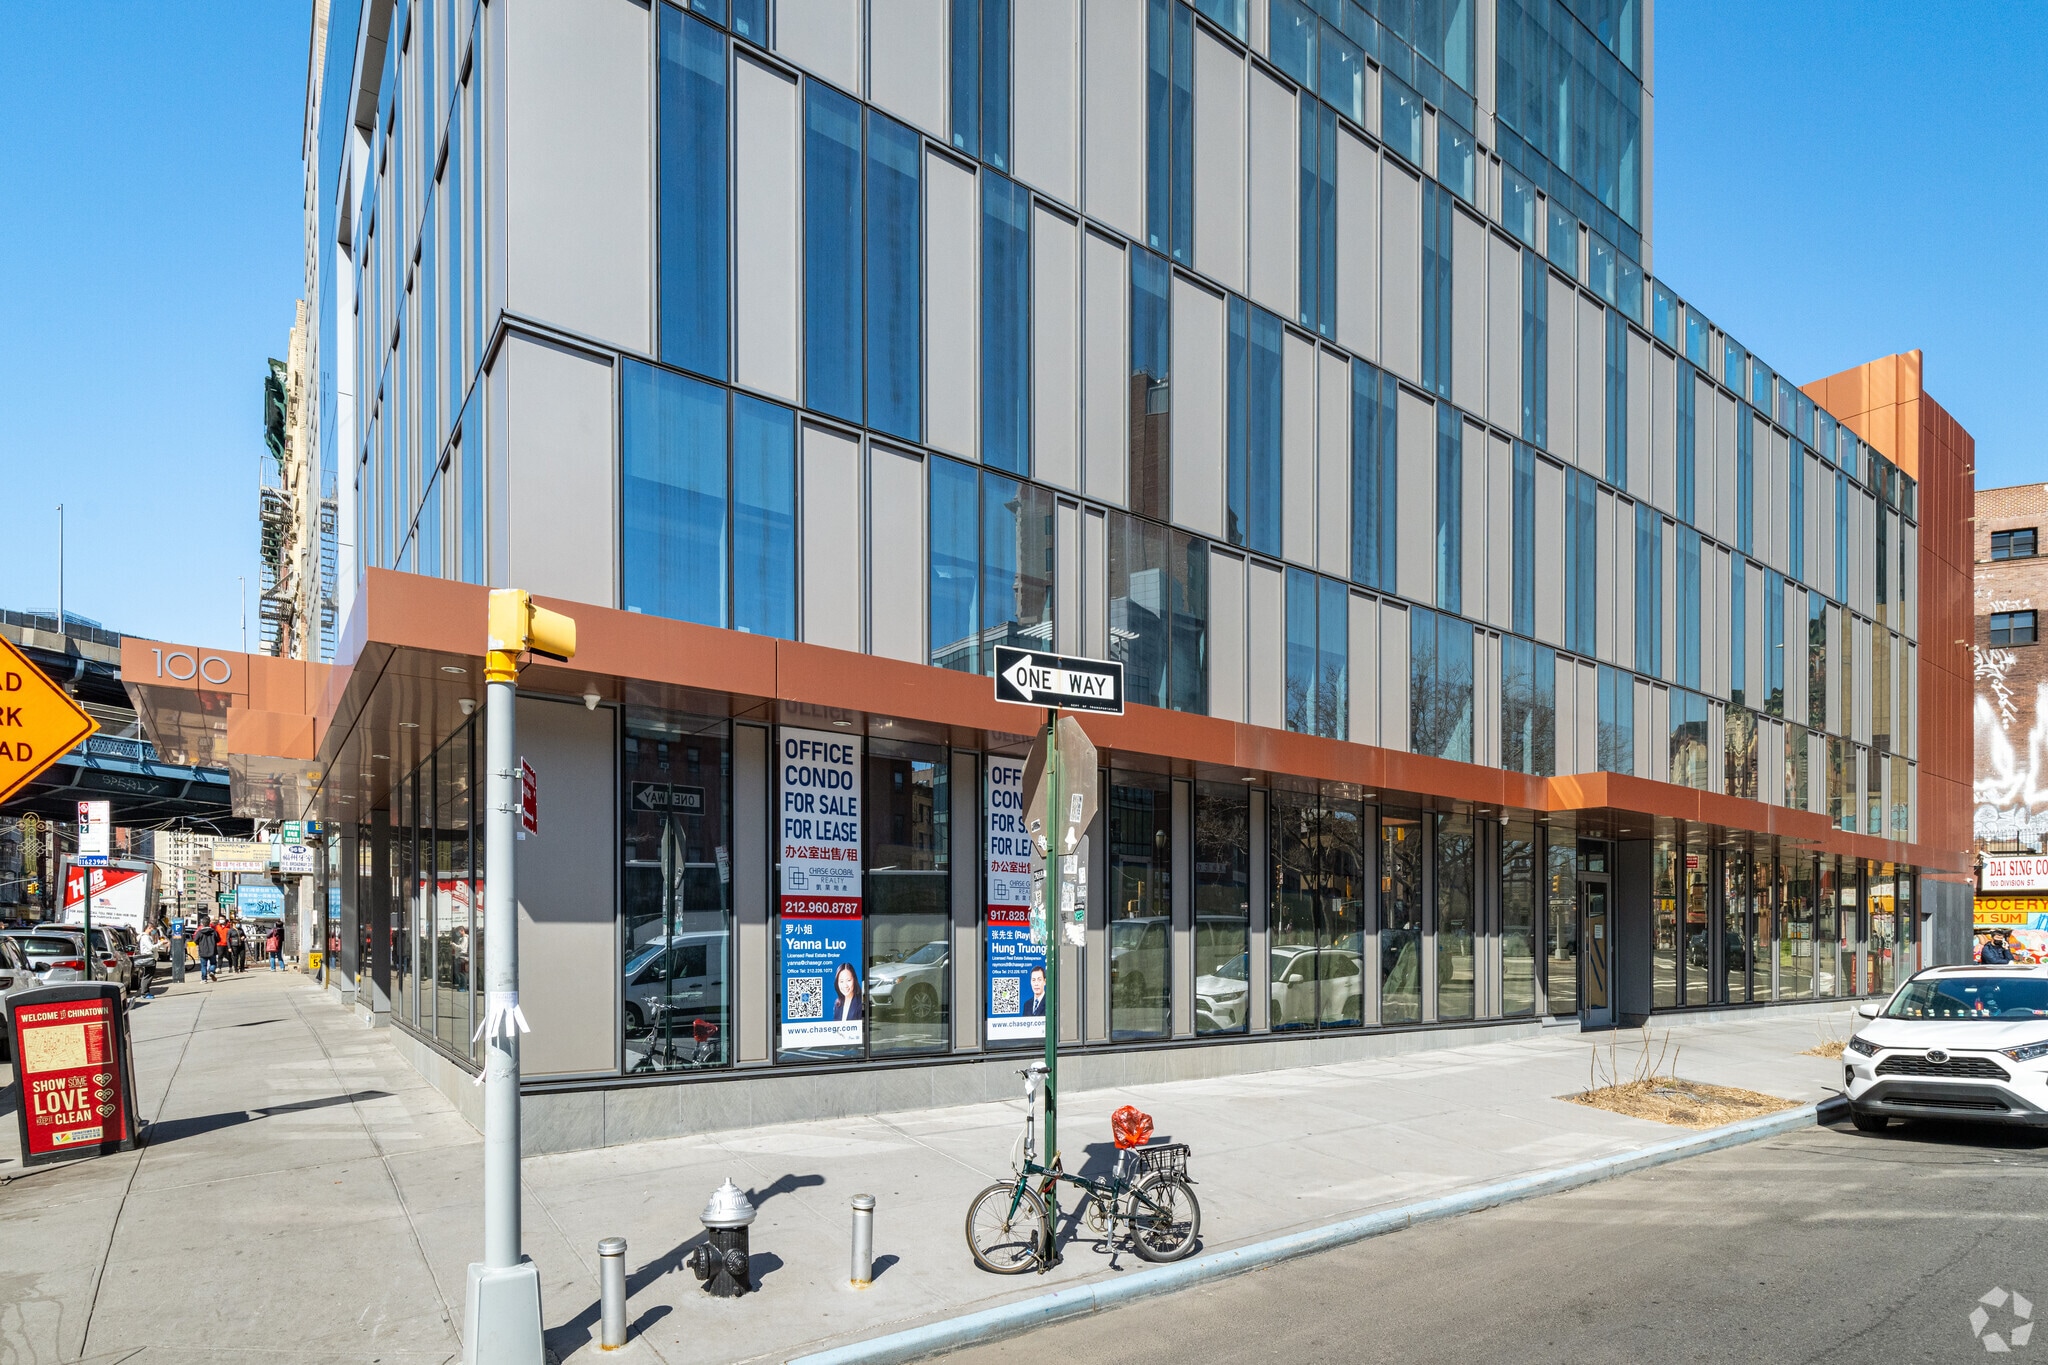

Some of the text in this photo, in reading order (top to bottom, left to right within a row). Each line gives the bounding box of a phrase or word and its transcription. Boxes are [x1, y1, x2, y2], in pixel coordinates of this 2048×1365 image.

[152, 648, 232, 684] 100
[0, 671, 22, 692] D
[1016, 666, 1106, 696] ONE WAY
[785, 738, 854, 765] OFFICE
[785, 765, 853, 790] CONDO
[785, 791, 857, 817] FOR SALE
[81, 824, 88, 833] 2
[785, 818, 857, 842] FOR LEASE
[991, 813, 1014, 832] FOR
[785, 844, 858, 862] 办公室出售/租
[991, 836, 1012, 855] FOR
[809, 867, 854, 876] CHASE GLOBAL
[1990, 861, 2006, 876] DAI
[2009, 860, 2032, 876] SING
[2000, 879, 2025, 887] DIVISION
[785, 901, 858, 914] 212.960.8787
[1990, 913, 2022, 923] SUM
[785, 924, 813, 935] 罗小姐
[991, 930, 1013, 940] 张先生
[785, 938, 847, 950] Yanna Luo
[991, 942, 1046, 956] Hung Truong
[313, 959, 318, 967] 5
[21, 1011, 59, 1023] WELCOME
[67, 1007, 109, 1018] CHINATOWN
[787, 1025, 858, 1035] www.chasegr.com
[33, 1076, 88, 1093] SHOW SOME
[33, 1087, 90, 1115] LOVE
[55, 1109, 92, 1125] CLEAN
